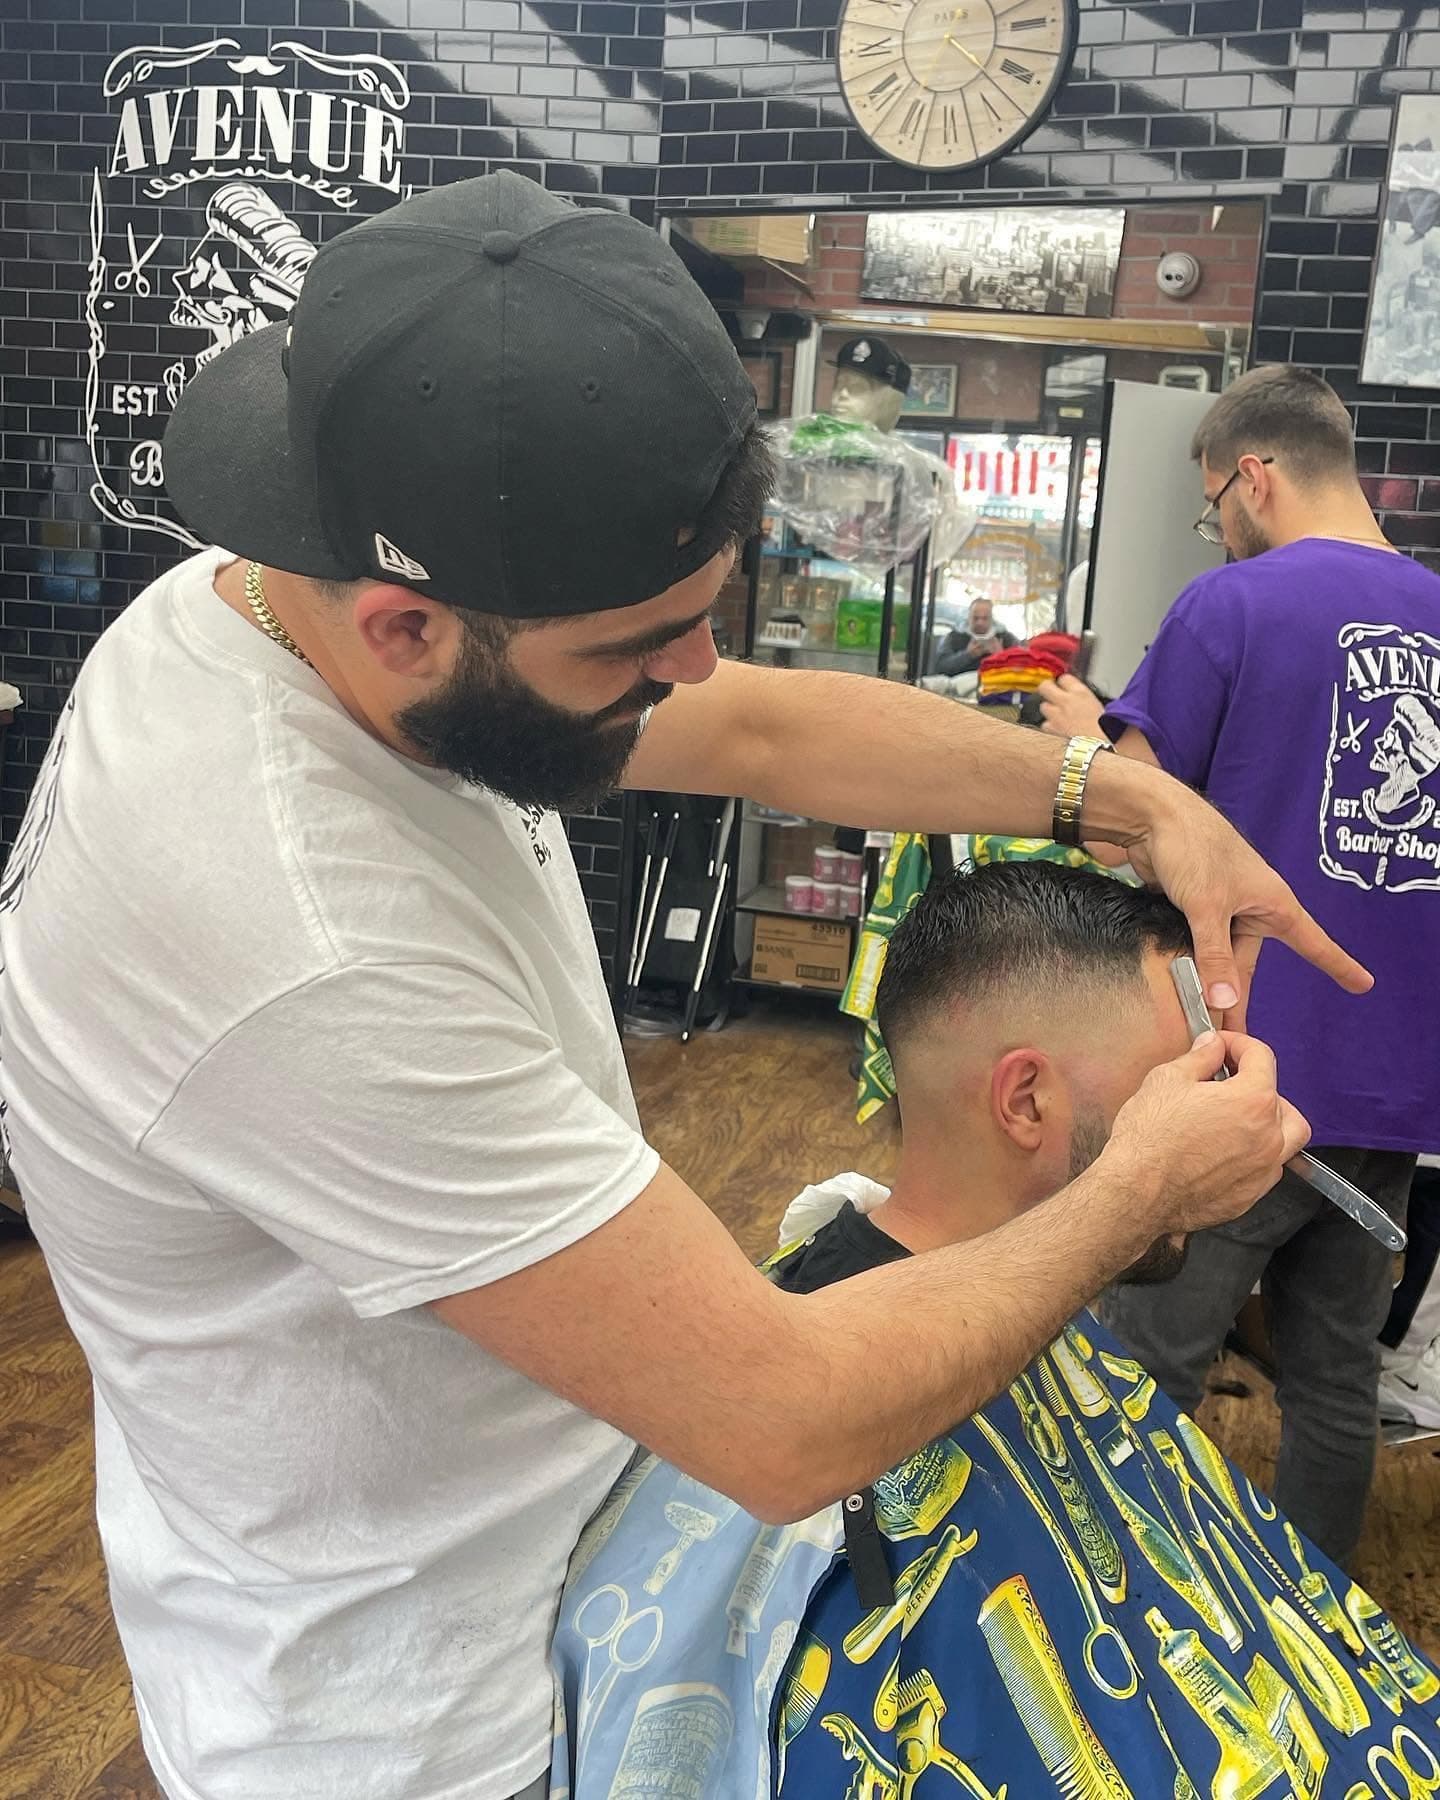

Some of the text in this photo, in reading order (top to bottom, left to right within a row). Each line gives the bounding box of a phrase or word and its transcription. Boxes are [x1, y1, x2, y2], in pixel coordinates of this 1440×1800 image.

[107, 85, 404, 195] AVENUE
[112, 384, 159, 417] EST
[1333, 797, 1363, 819] EST.
[1336, 825, 1394, 855] Barber
[905, 1567, 941, 1616] PERFECT
